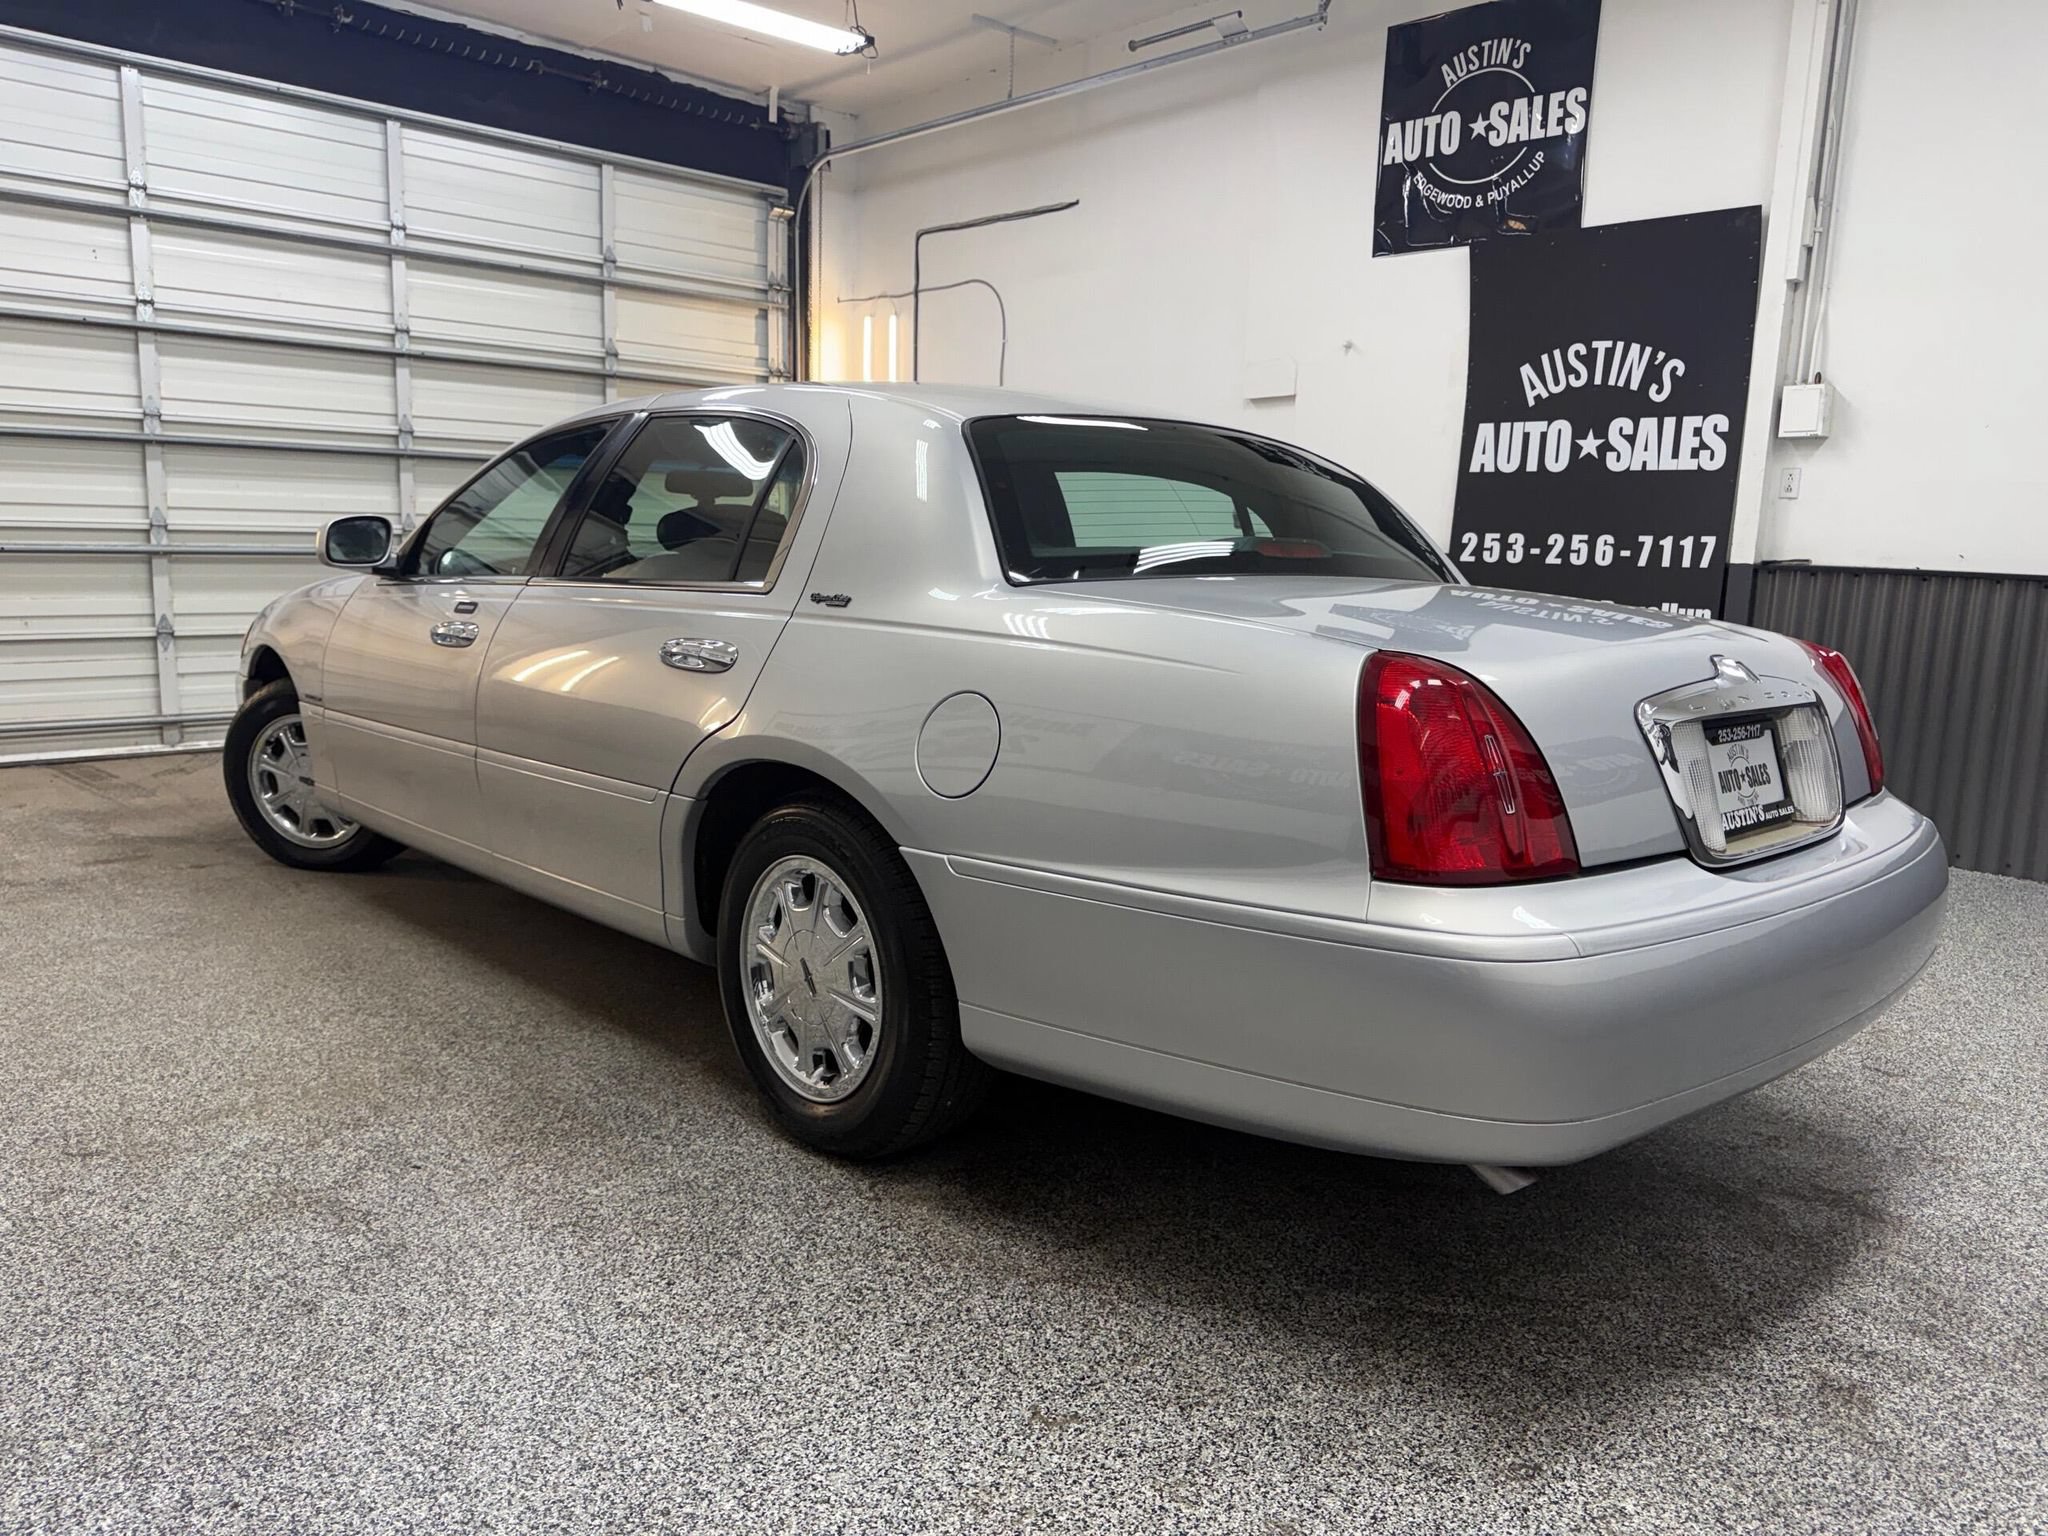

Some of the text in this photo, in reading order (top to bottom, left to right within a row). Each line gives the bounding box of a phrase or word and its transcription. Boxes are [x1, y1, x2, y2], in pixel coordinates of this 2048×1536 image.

[1440, 37, 1532, 88] AUSTIN'S
[1383, 86, 1587, 166] AUTO SALES
[1413, 150, 1546, 209] EDGEWOOD & PUYALLUP
[1519, 340, 1686, 408] AUSTIN'S
[1469, 413, 1730, 473] AUTO SALES
[1459, 532, 1717, 569] 253-256-7117
[1717, 724, 1761, 743] 253-256-7117
[1718, 763, 1771, 794] AUTO SALES
[1721, 804, 1795, 831] AUSTIN'S AUTO SALES
